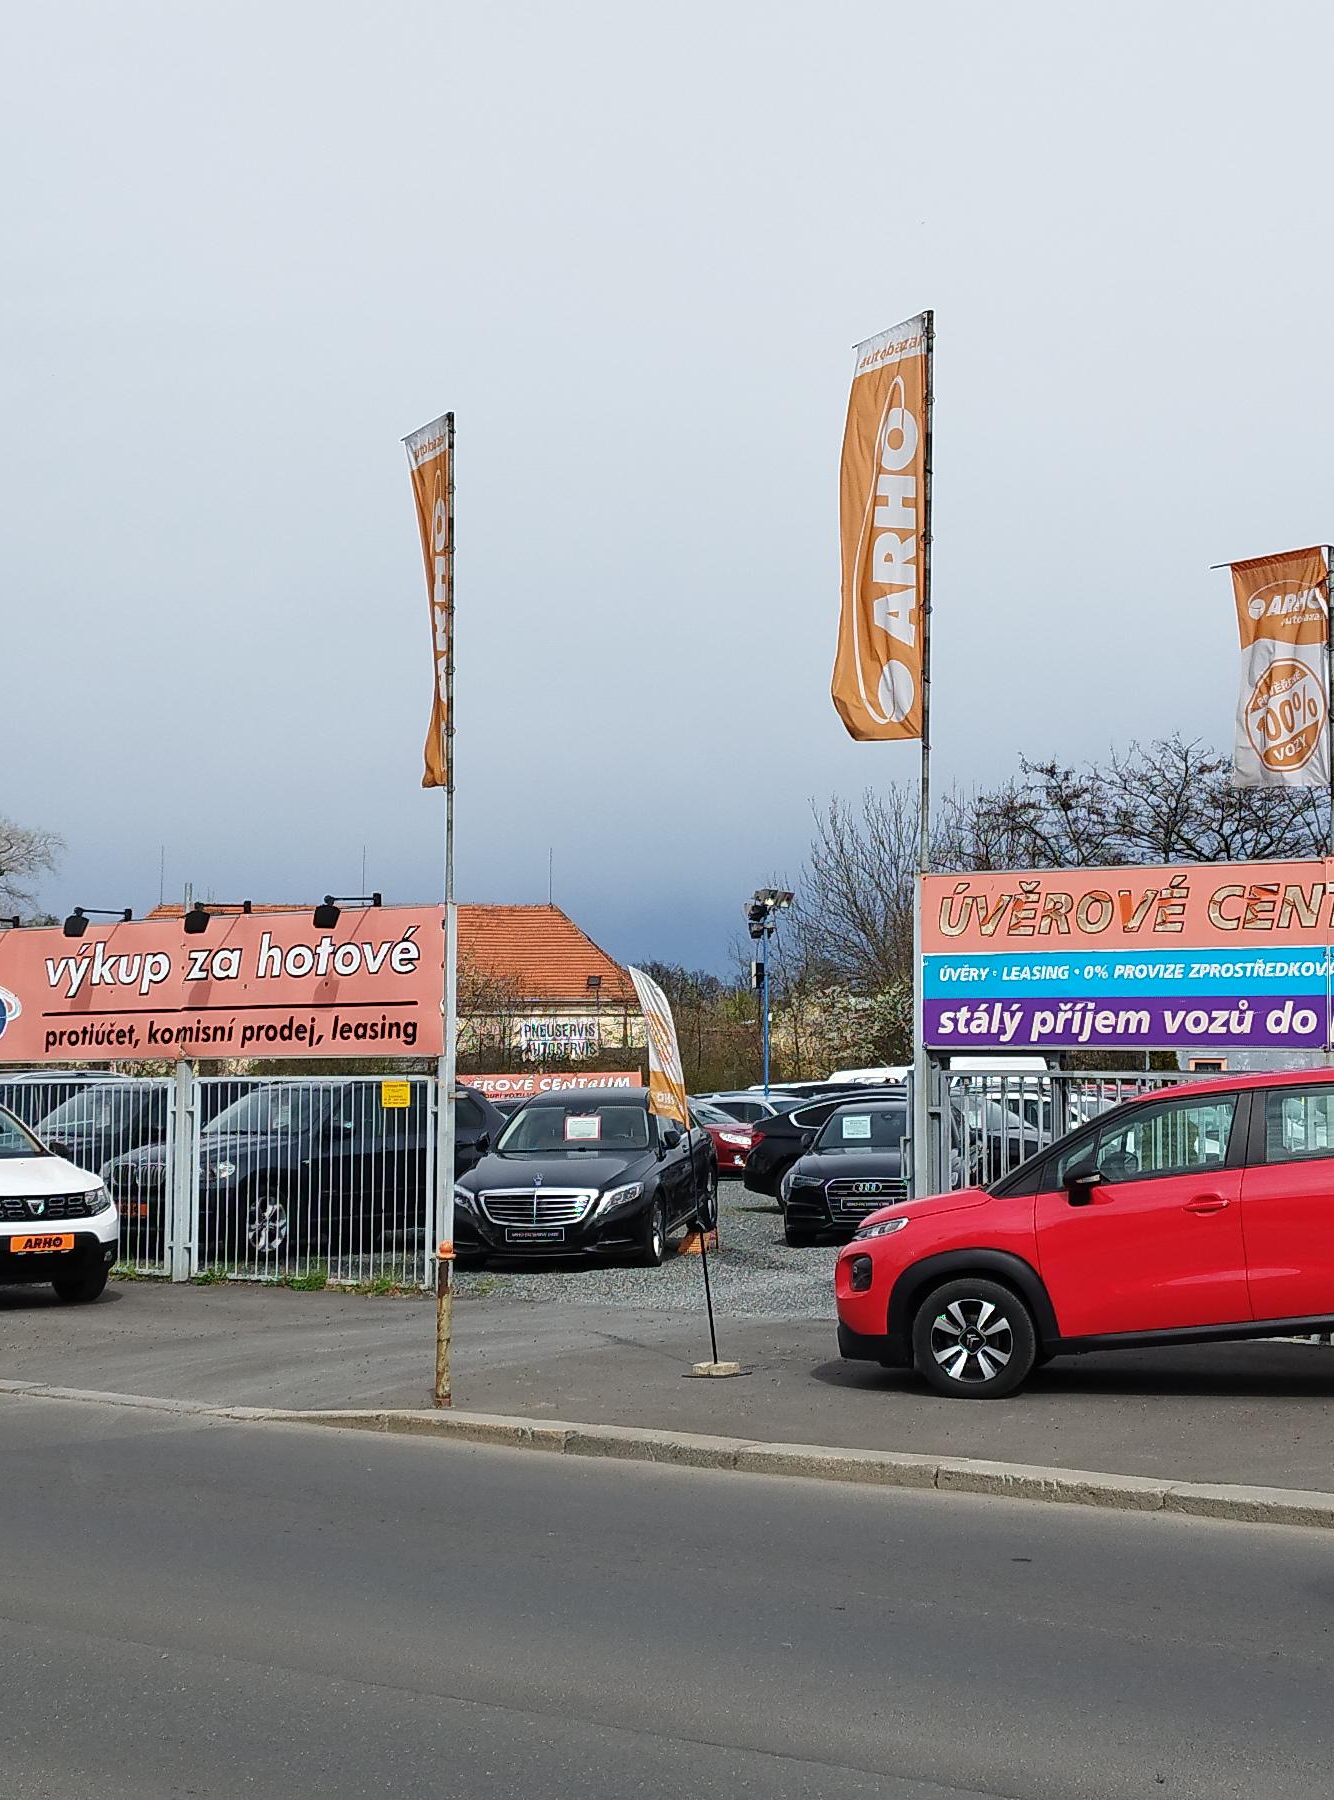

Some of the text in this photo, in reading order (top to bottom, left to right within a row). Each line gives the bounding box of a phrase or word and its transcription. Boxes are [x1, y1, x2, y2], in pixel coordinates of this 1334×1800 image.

[873, 407, 919, 648] ARHO
[938, 874, 1190, 937] ÚVĚROVÉ
[45, 925, 420, 998] výkup za hotové
[939, 963, 990, 982] ÚVĚRY
[1002, 965, 1069, 980] LEASING
[1083, 964, 1109, 979] 0%
[1113, 963, 1184, 979] PROVIZE
[45, 1014, 418, 1052] protiúčet, komisní prodej, leasing
[524, 1022, 596, 1038] PNEUSERVIS
[937, 1002, 1022, 1042] stálý
[1029, 1001, 1151, 1042] příjem
[1163, 1000, 1255, 1034] vozů
[1266, 1000, 1317, 1034] do
[526, 1041, 597, 1057] AUTOSERVIS
[23, 1237, 63, 1249] ARHO
